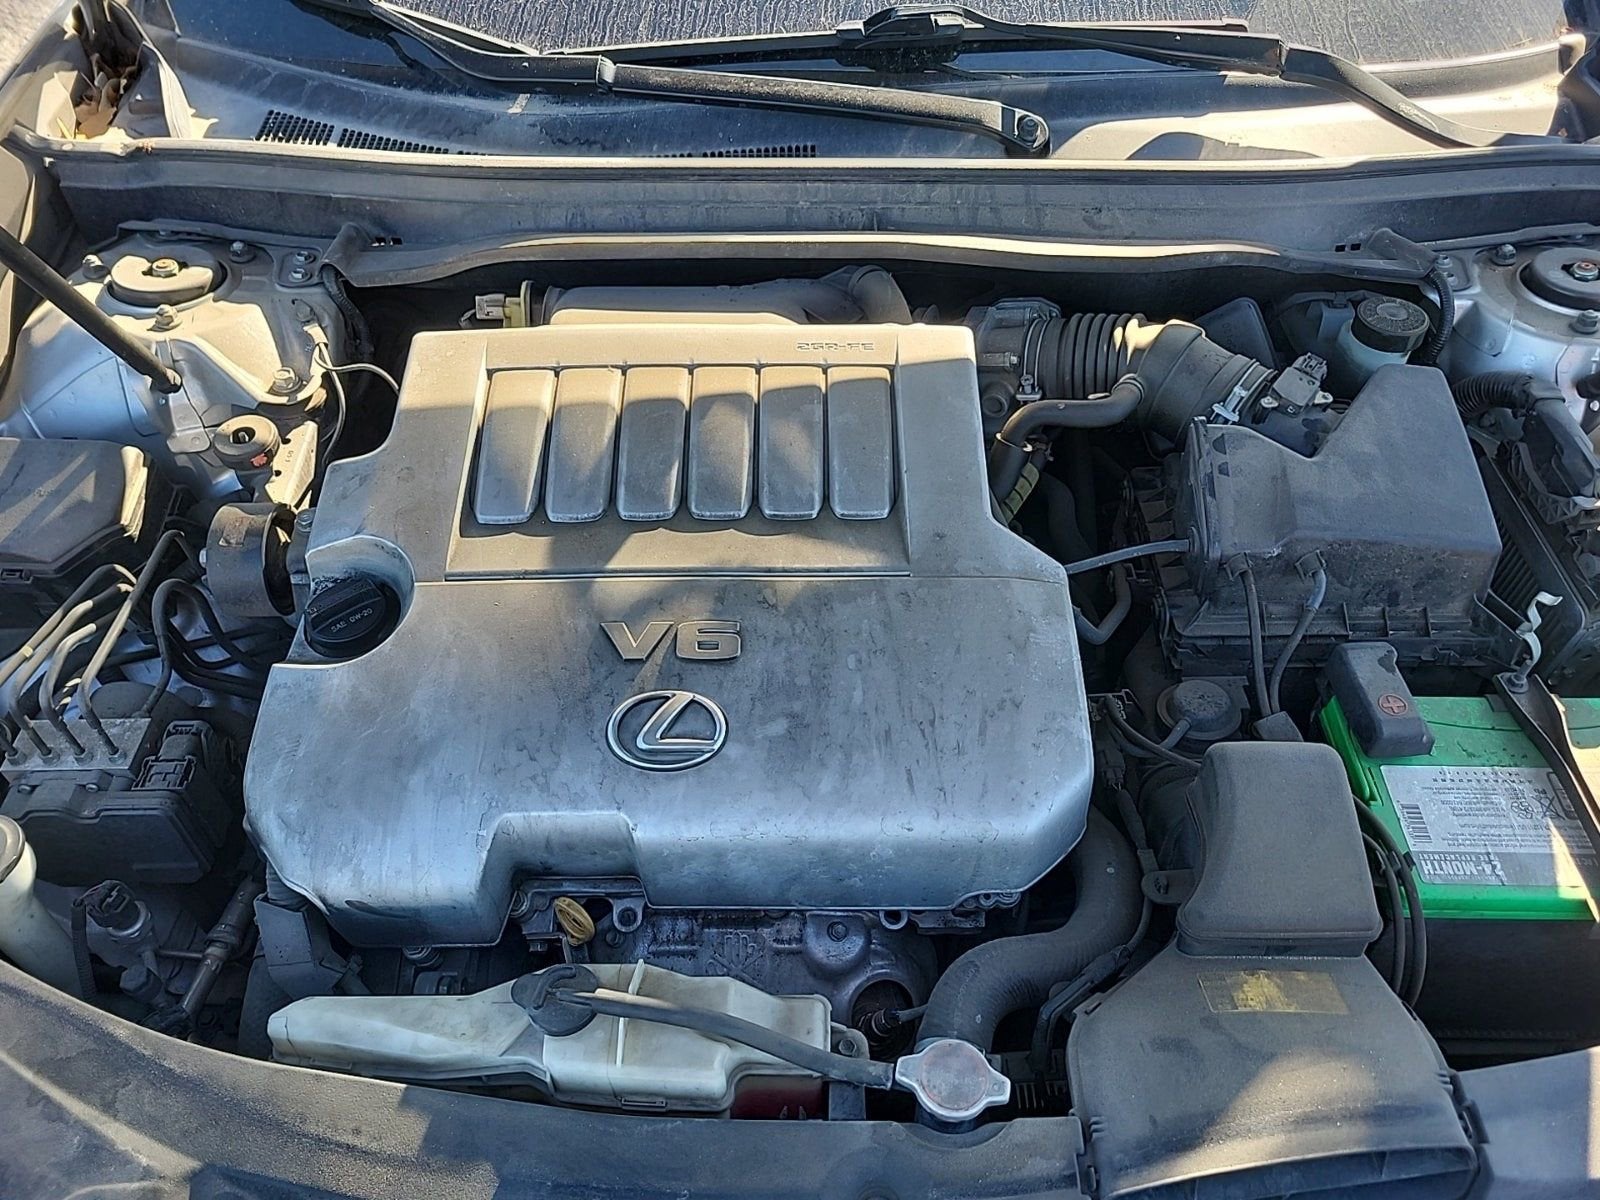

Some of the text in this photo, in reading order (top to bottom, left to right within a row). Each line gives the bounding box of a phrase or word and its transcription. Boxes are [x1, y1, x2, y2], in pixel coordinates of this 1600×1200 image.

[796, 341, 875, 351] 2GR-FE
[330, 607, 373, 633] SAE 0W-20
[600, 620, 743, 661] V6
[1418, 853, 1476, 861] REPLACEMENT
[1420, 860, 1502, 876] 24-MONTH
